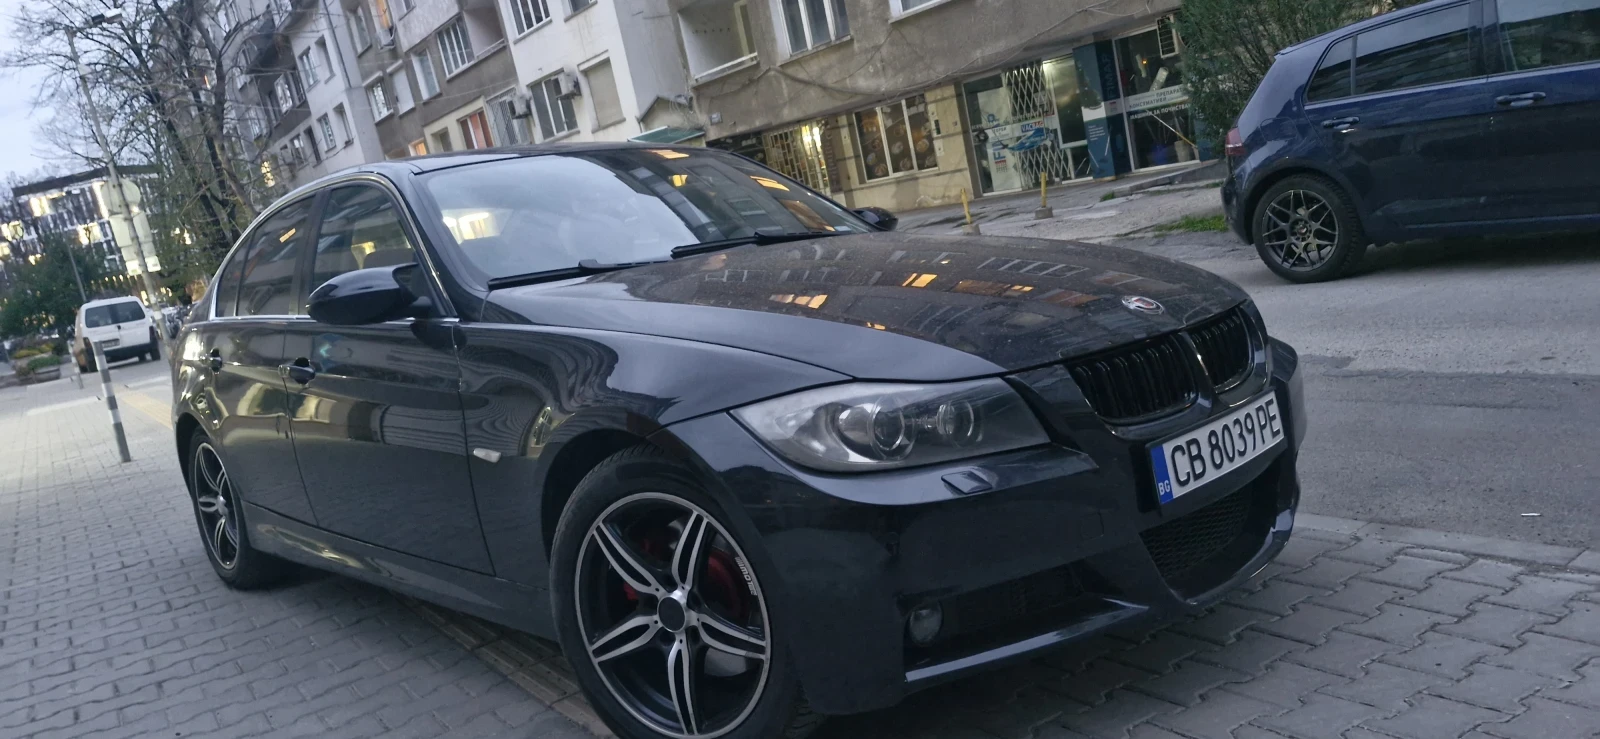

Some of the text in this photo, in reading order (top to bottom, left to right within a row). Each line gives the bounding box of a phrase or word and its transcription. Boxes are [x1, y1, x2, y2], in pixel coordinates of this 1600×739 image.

[1156, 87, 1184, 98] ПРЕПАРАТ
[1170, 398, 1281, 487] CB 8039 PE
[1158, 480, 1171, 496] BG
